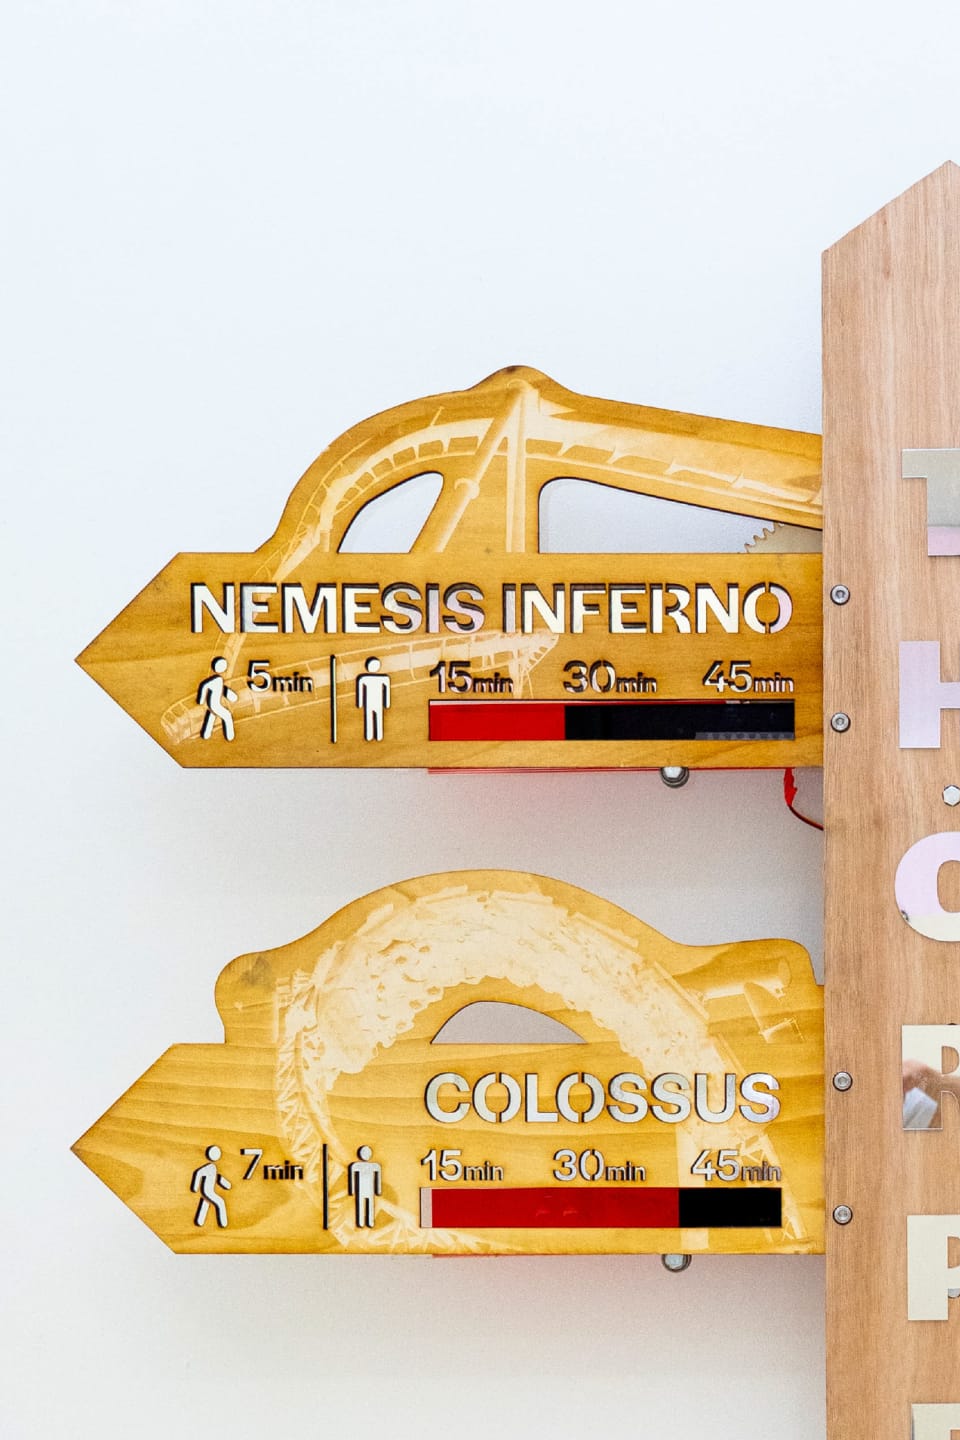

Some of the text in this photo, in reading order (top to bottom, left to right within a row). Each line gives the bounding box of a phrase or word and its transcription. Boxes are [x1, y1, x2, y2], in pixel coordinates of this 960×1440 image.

[190, 581, 793, 634] NEMESIS INFERNO
[246, 659, 313, 694] 5min
[429, 659, 795, 694] 15min 30min 45min
[424, 1072, 782, 1124] COLOSSUS
[420, 1148, 783, 1182] 15min 30min 45min
